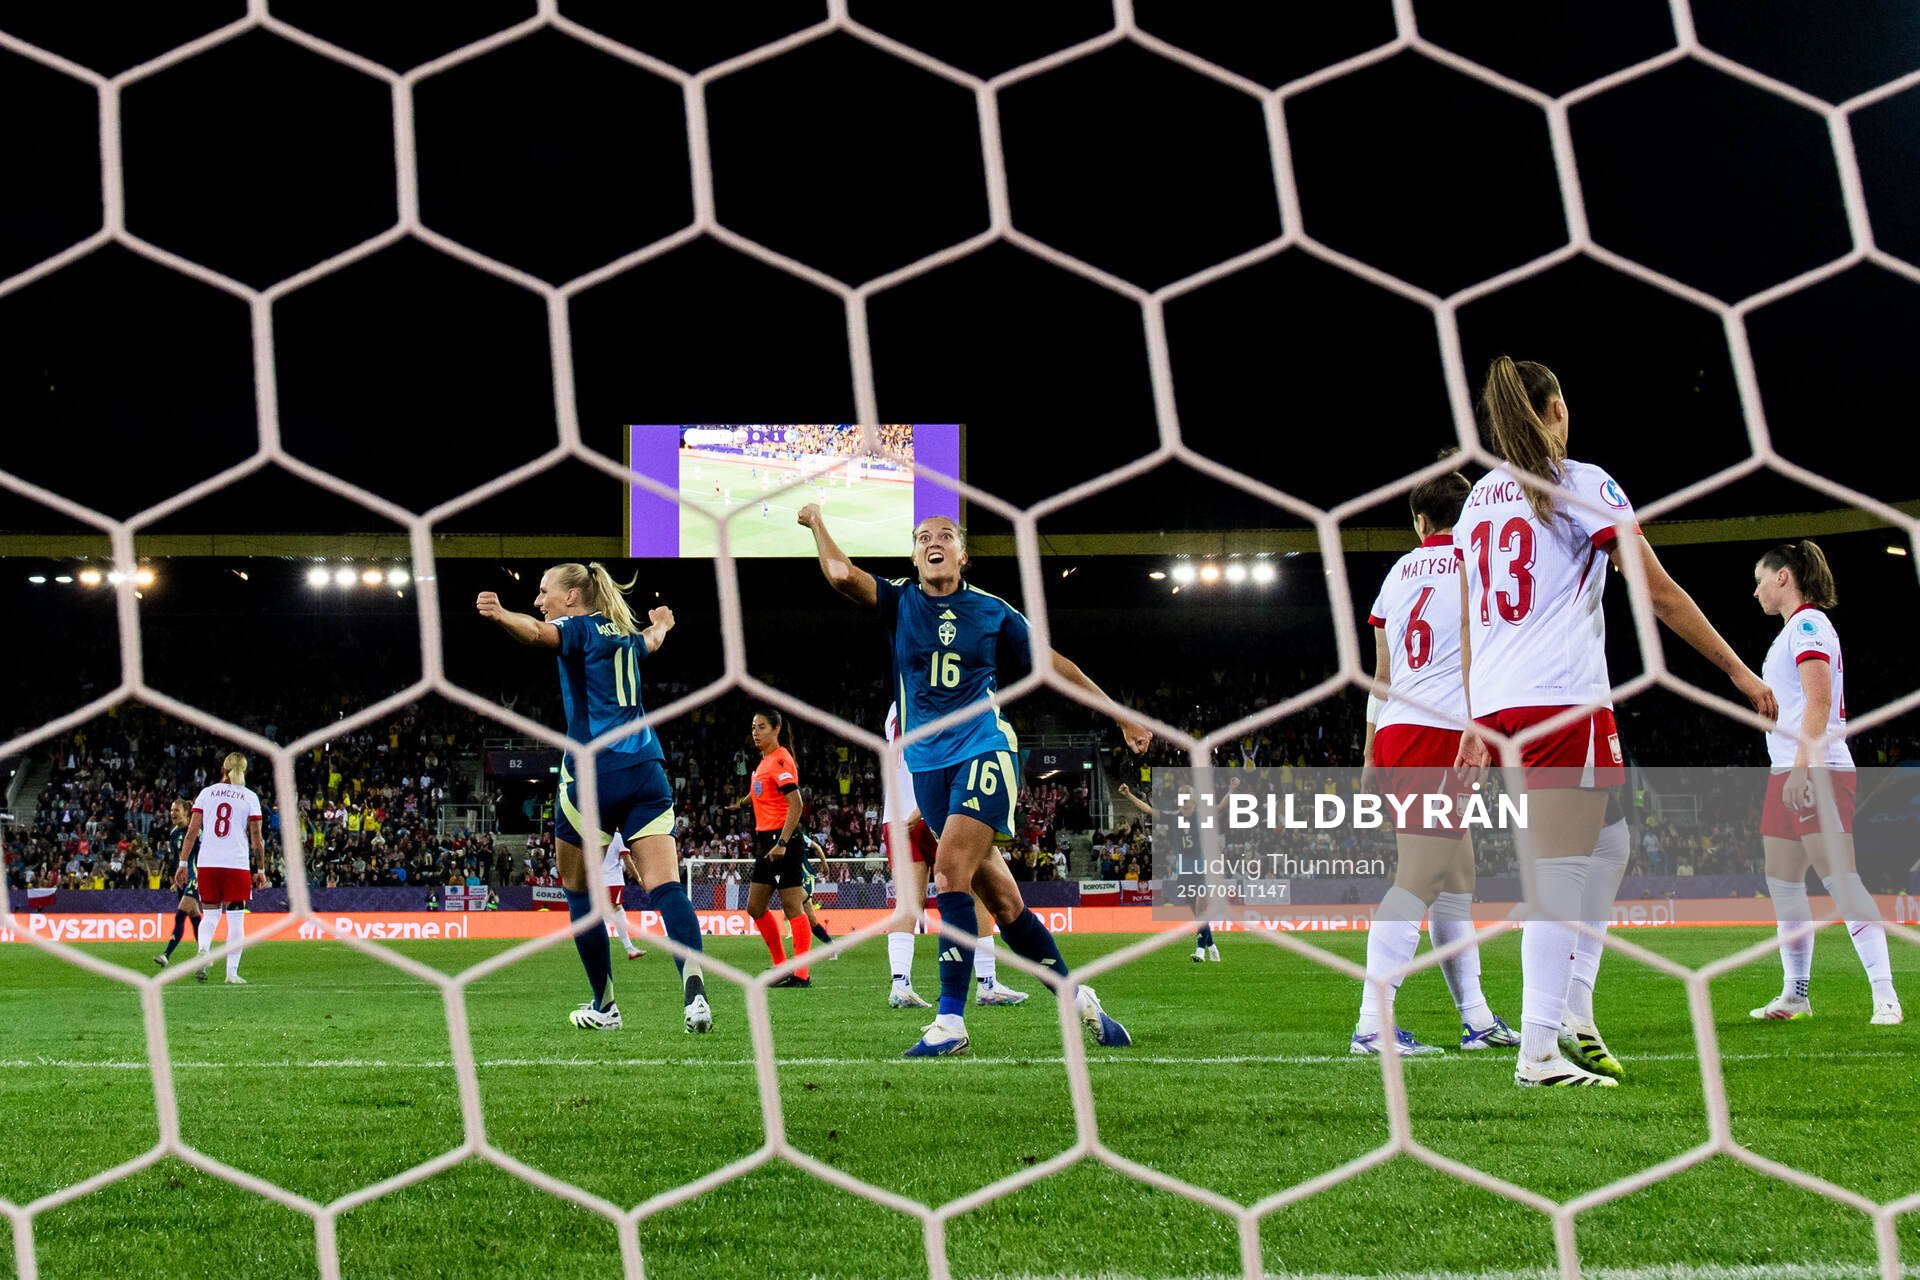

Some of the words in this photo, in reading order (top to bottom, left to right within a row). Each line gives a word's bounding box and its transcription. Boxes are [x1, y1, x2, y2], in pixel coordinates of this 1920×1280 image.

[1471, 516, 1537, 626] 13
[1404, 586, 1435, 673] 6
[614, 646, 637, 707] 11
[930, 650, 961, 688] 16
[509, 759, 522, 768] B2
[966, 758, 1000, 796] 16
[1043, 755, 1057, 764] B3
[210, 789, 246, 801] KAMCZYK
[214, 801, 233, 839] 8
[1182, 835, 1193, 848] 15
[29, 913, 162, 941] Pyszne.pl
